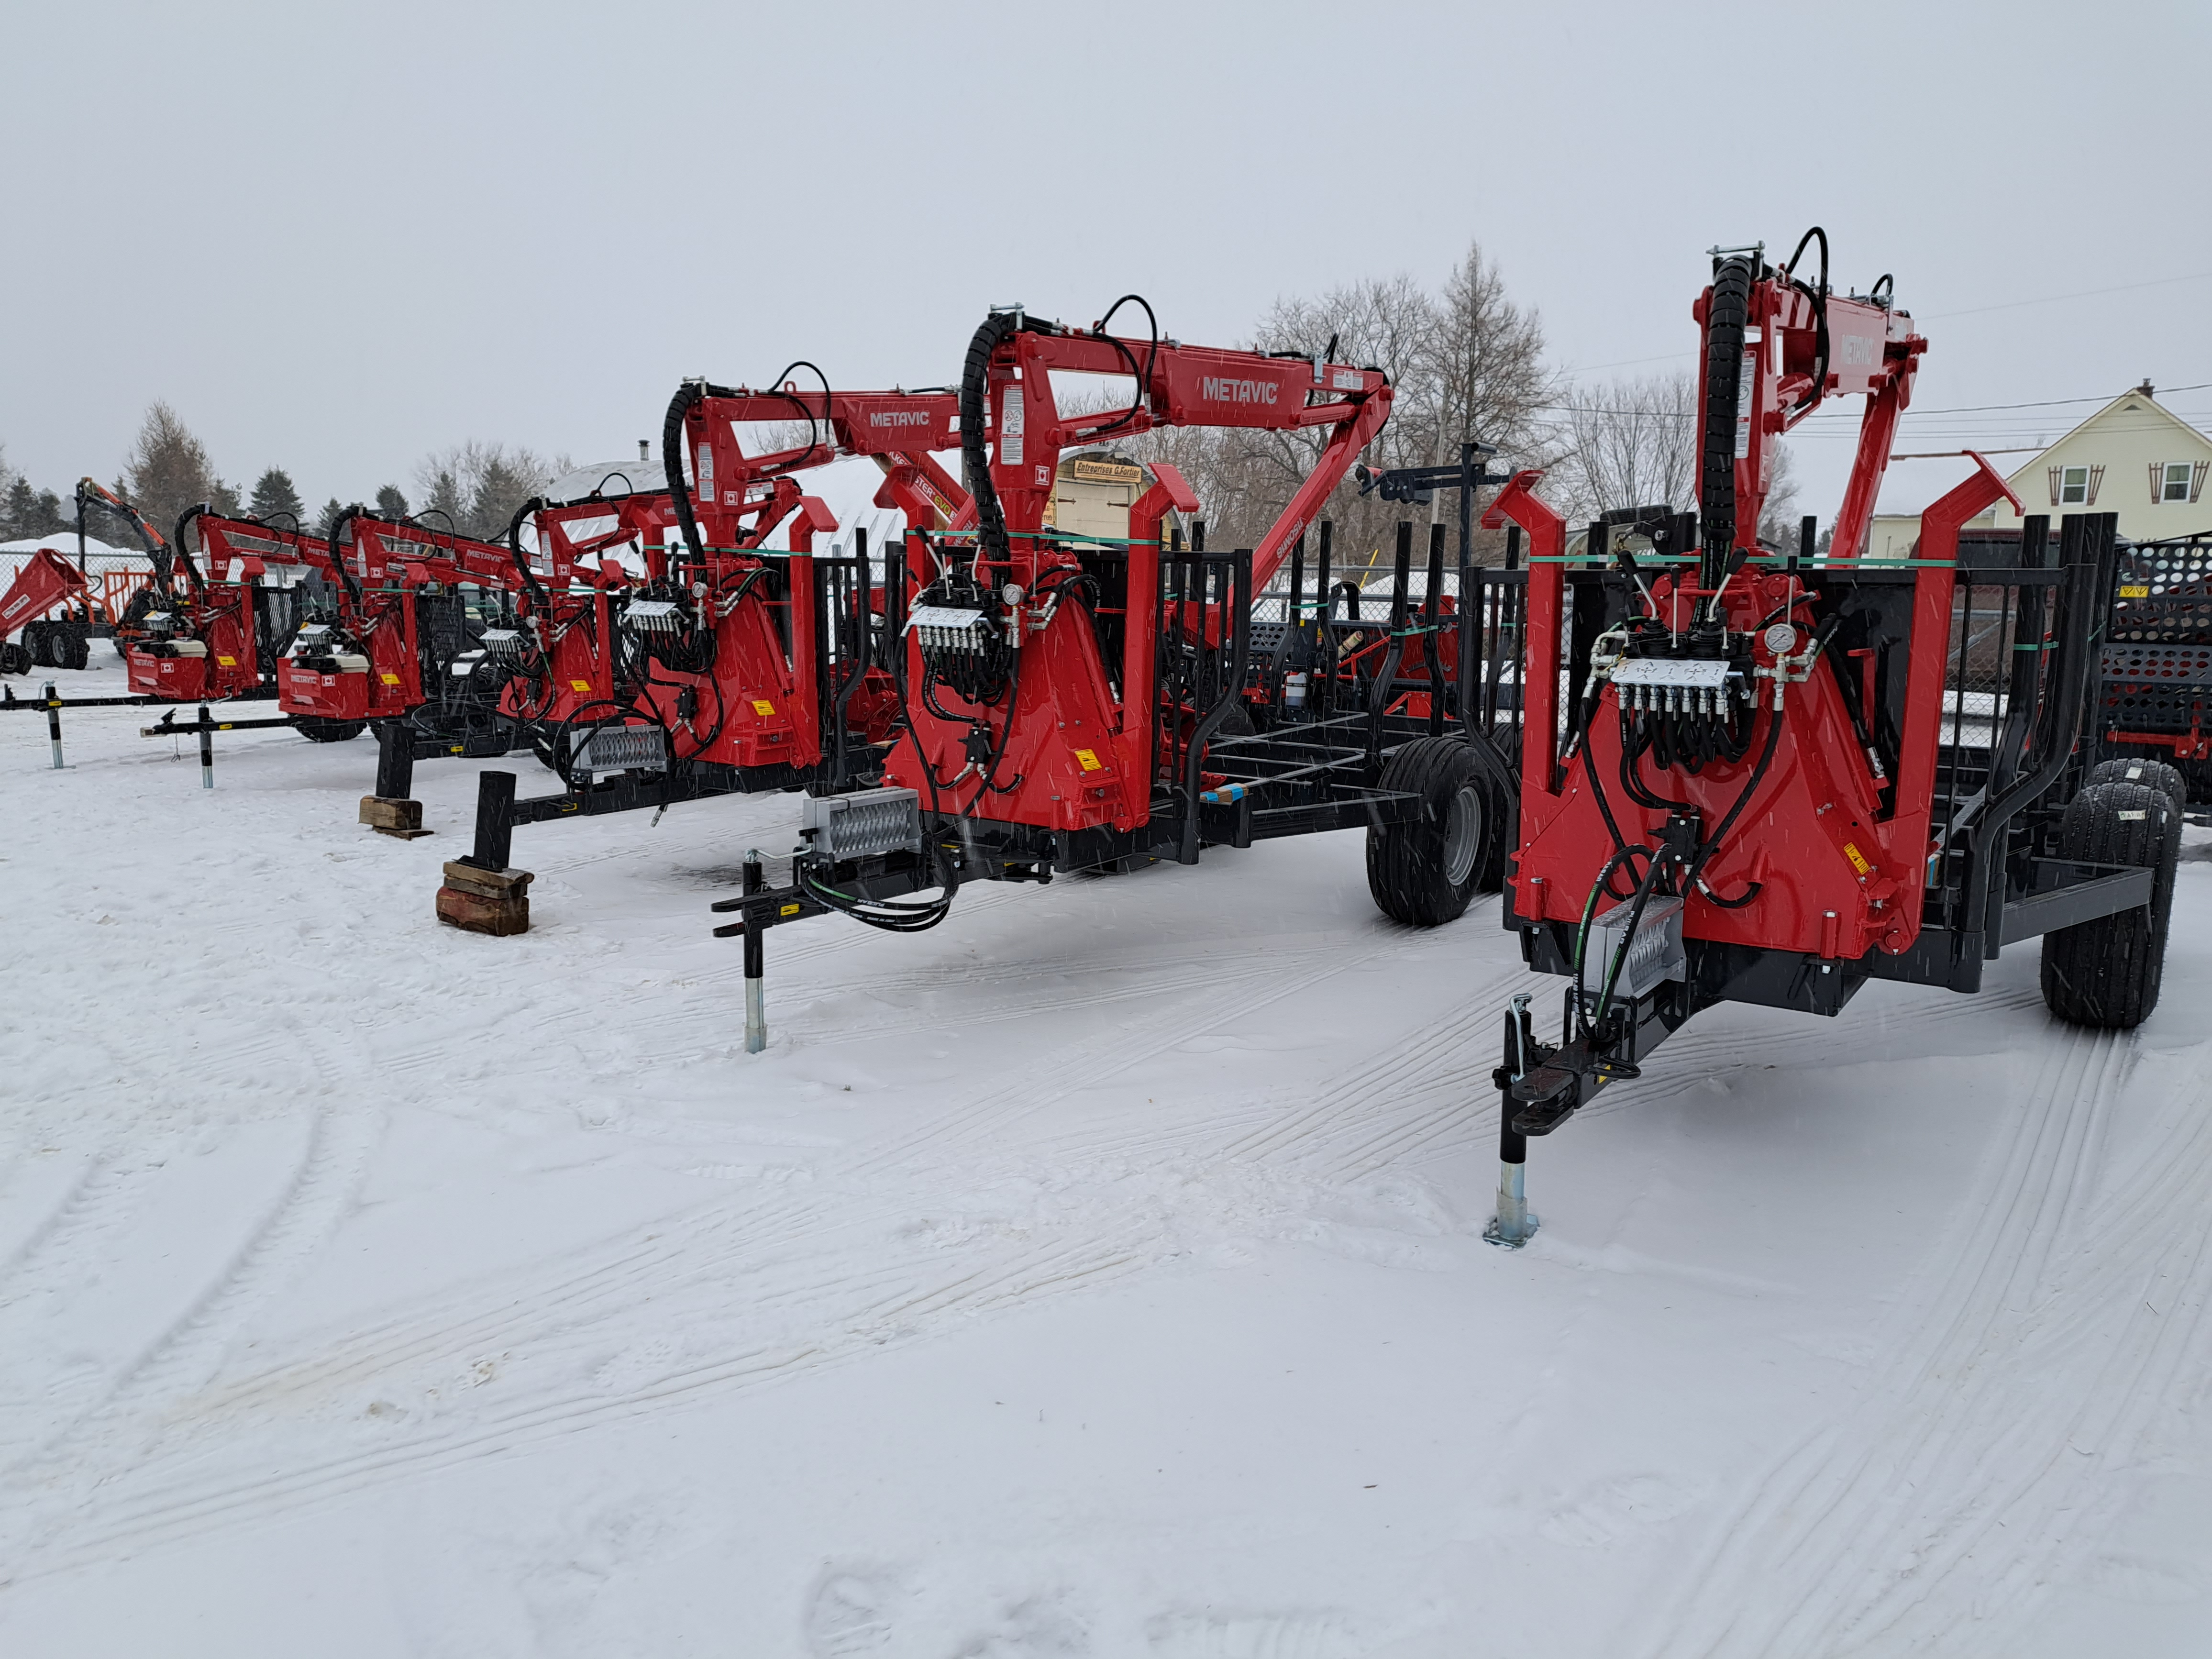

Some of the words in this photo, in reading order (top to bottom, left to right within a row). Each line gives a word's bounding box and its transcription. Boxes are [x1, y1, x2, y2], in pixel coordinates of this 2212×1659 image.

[1203, 376, 1278, 404] METAVIC
[870, 411, 929, 427] METAVIC
[1077, 462, 1112, 475] Entreprises
[1114, 466, 1140, 476] G.Fortier
[934, 495, 951, 515] EVO
